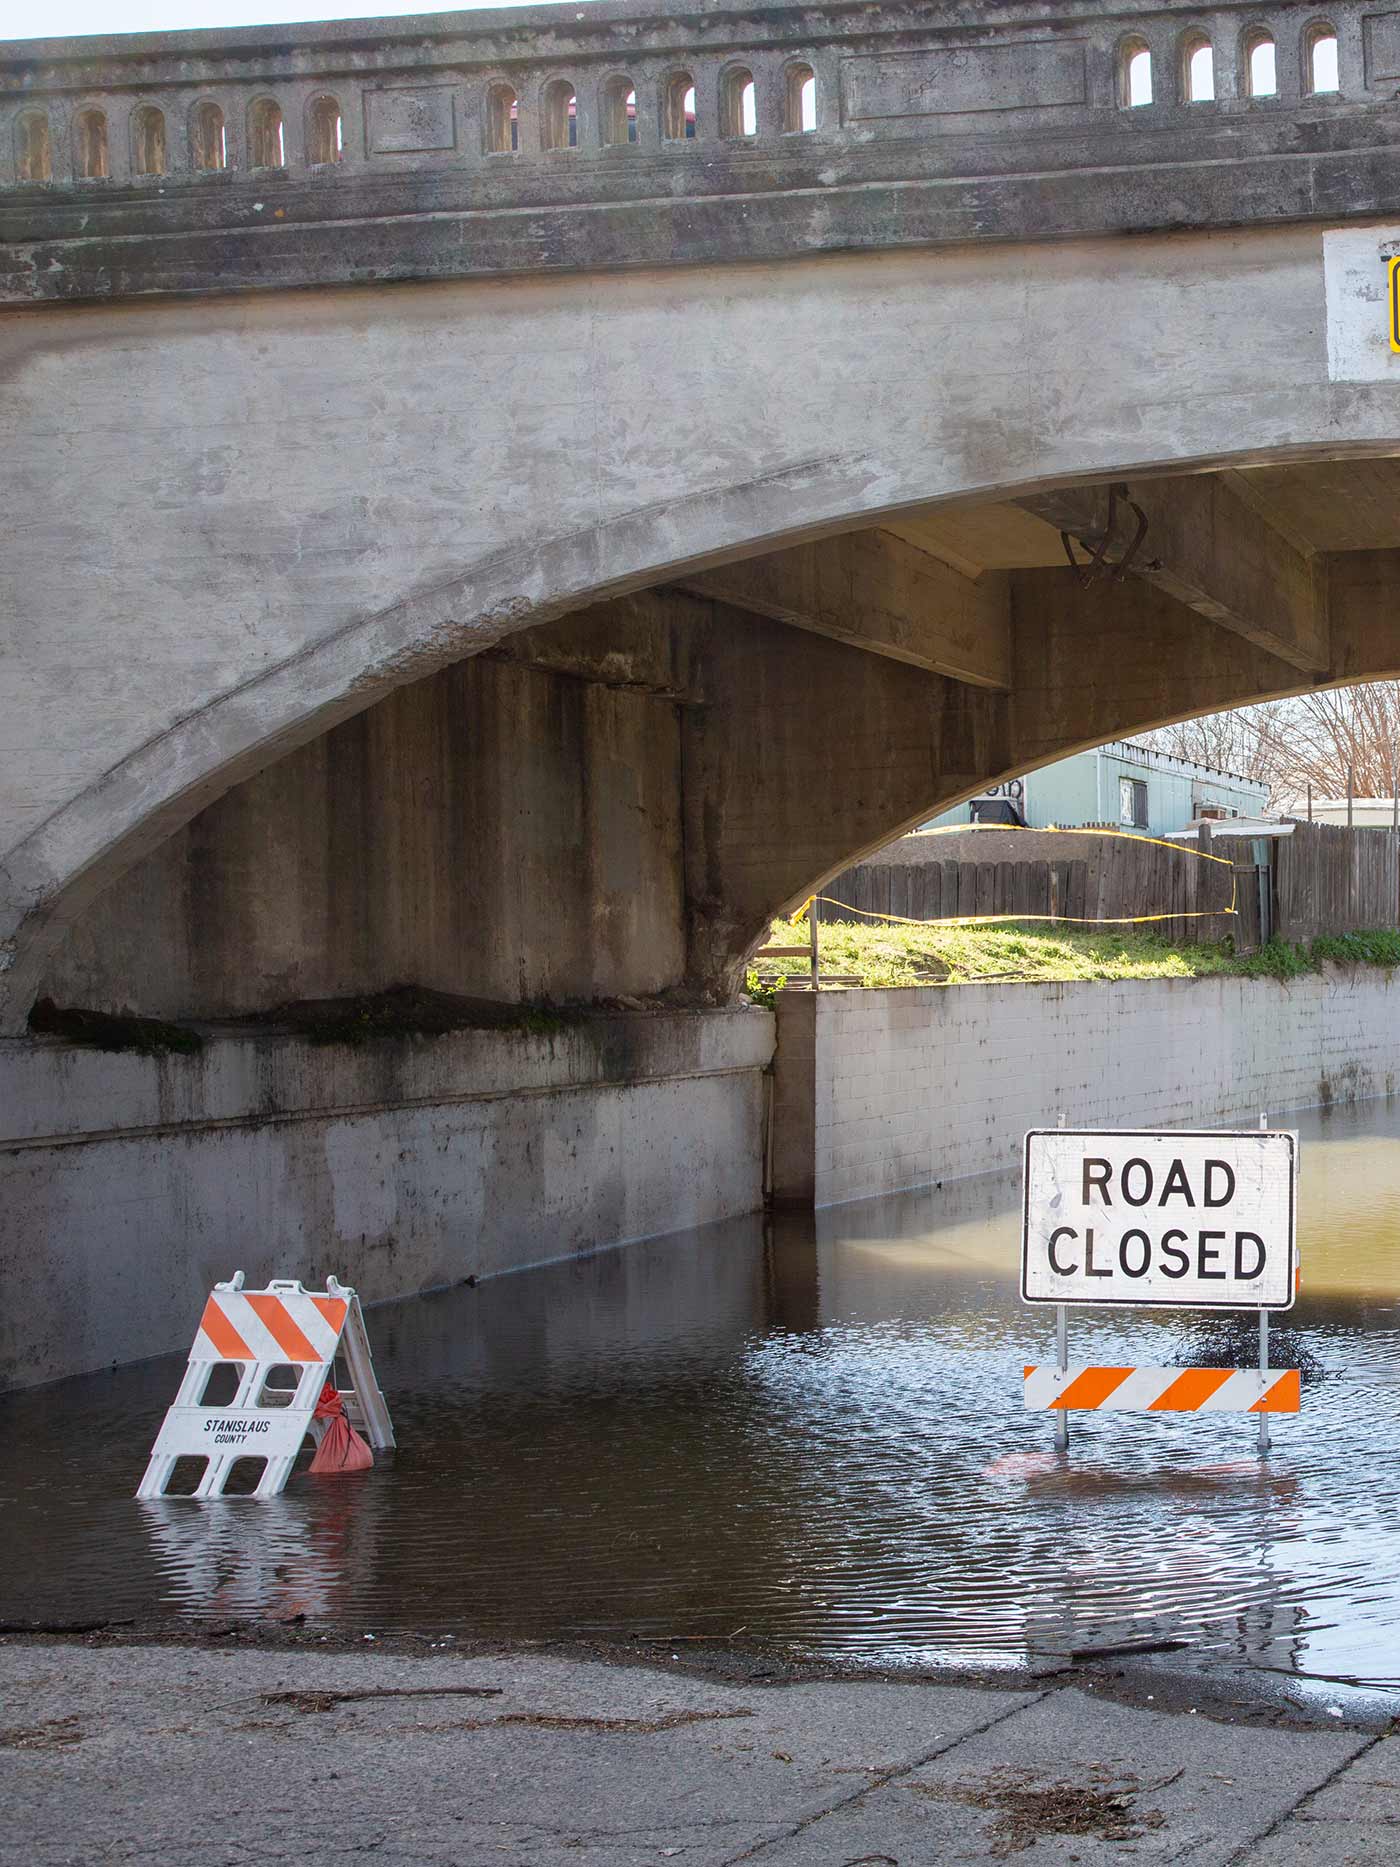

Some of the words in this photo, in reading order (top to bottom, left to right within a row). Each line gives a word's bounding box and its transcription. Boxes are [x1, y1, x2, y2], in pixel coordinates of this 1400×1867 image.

[1081, 1157, 1236, 1208] ROAD
[1047, 1226, 1267, 1280] CLOSED
[203, 1419, 271, 1433] STANISLAUS
[214, 1434, 248, 1444] COUNTY
